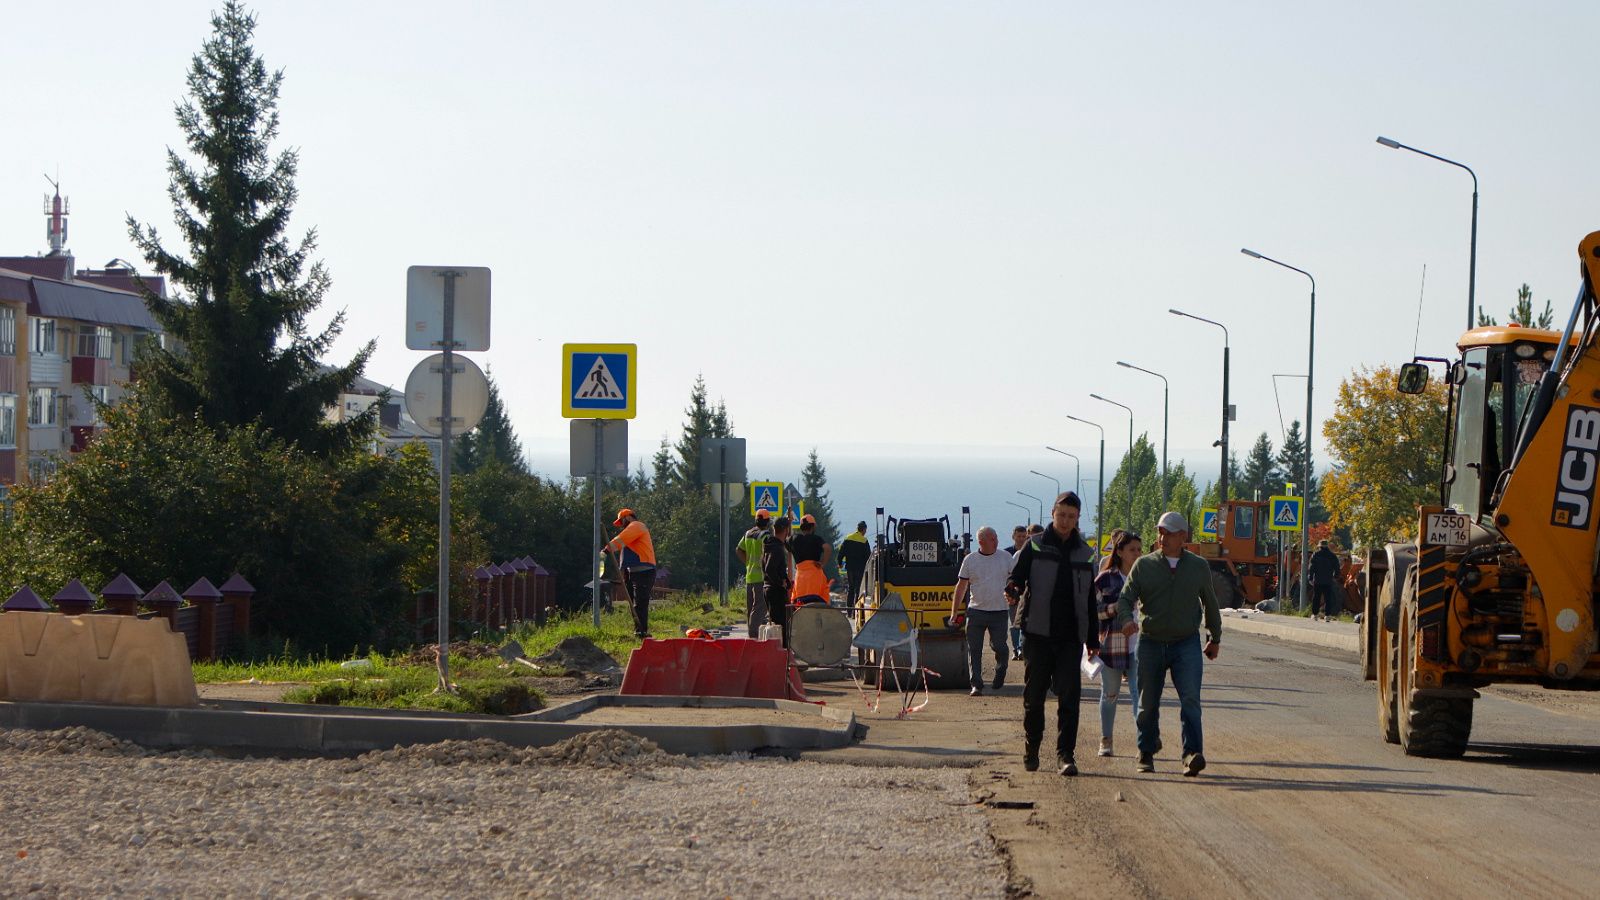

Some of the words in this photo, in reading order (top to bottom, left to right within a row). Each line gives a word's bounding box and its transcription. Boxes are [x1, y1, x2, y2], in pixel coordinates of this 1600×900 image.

[1558, 409, 1600, 526] JCB
[1433, 516, 1465, 529] 7550
[1455, 531, 1466, 540] 16
[912, 543, 934, 551] 8806
